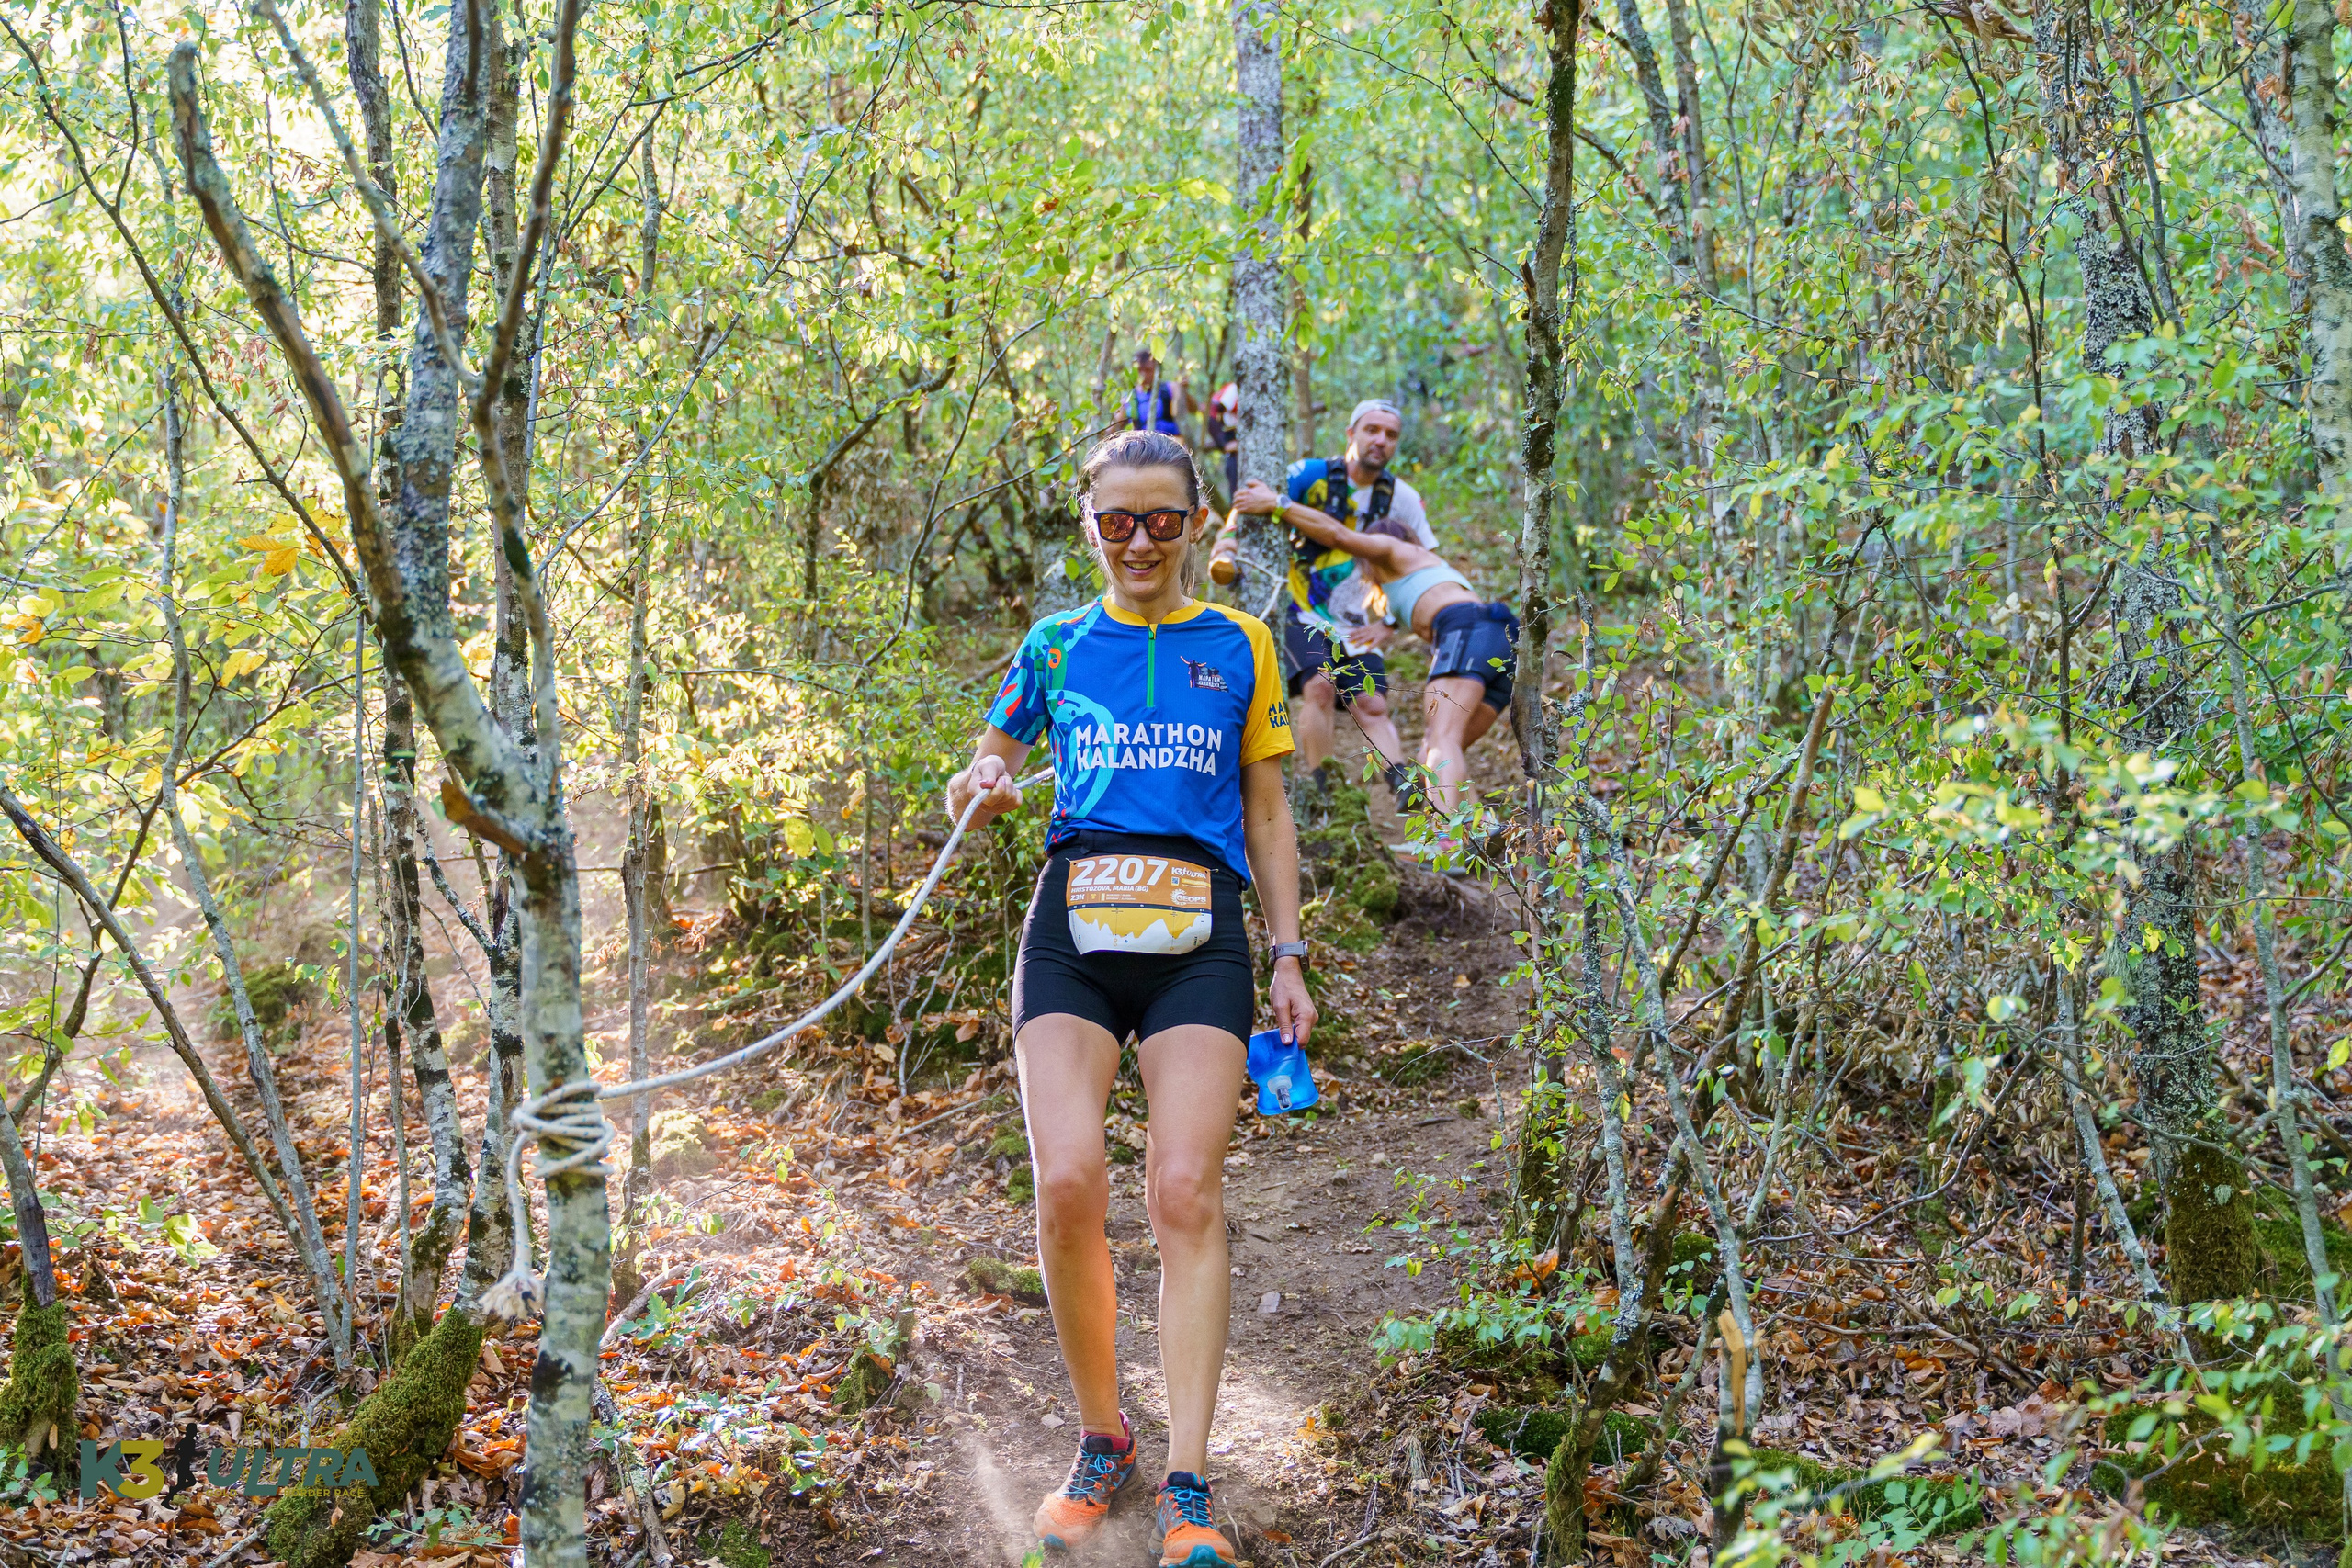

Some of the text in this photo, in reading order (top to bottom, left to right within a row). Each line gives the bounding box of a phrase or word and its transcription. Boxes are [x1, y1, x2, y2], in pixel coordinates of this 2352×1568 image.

[1268, 701, 1286, 716] MA
[1075, 722, 1222, 751] MARATHON
[1077, 746, 1216, 777] KALANDZHA
[1071, 857, 1169, 887] 2207
